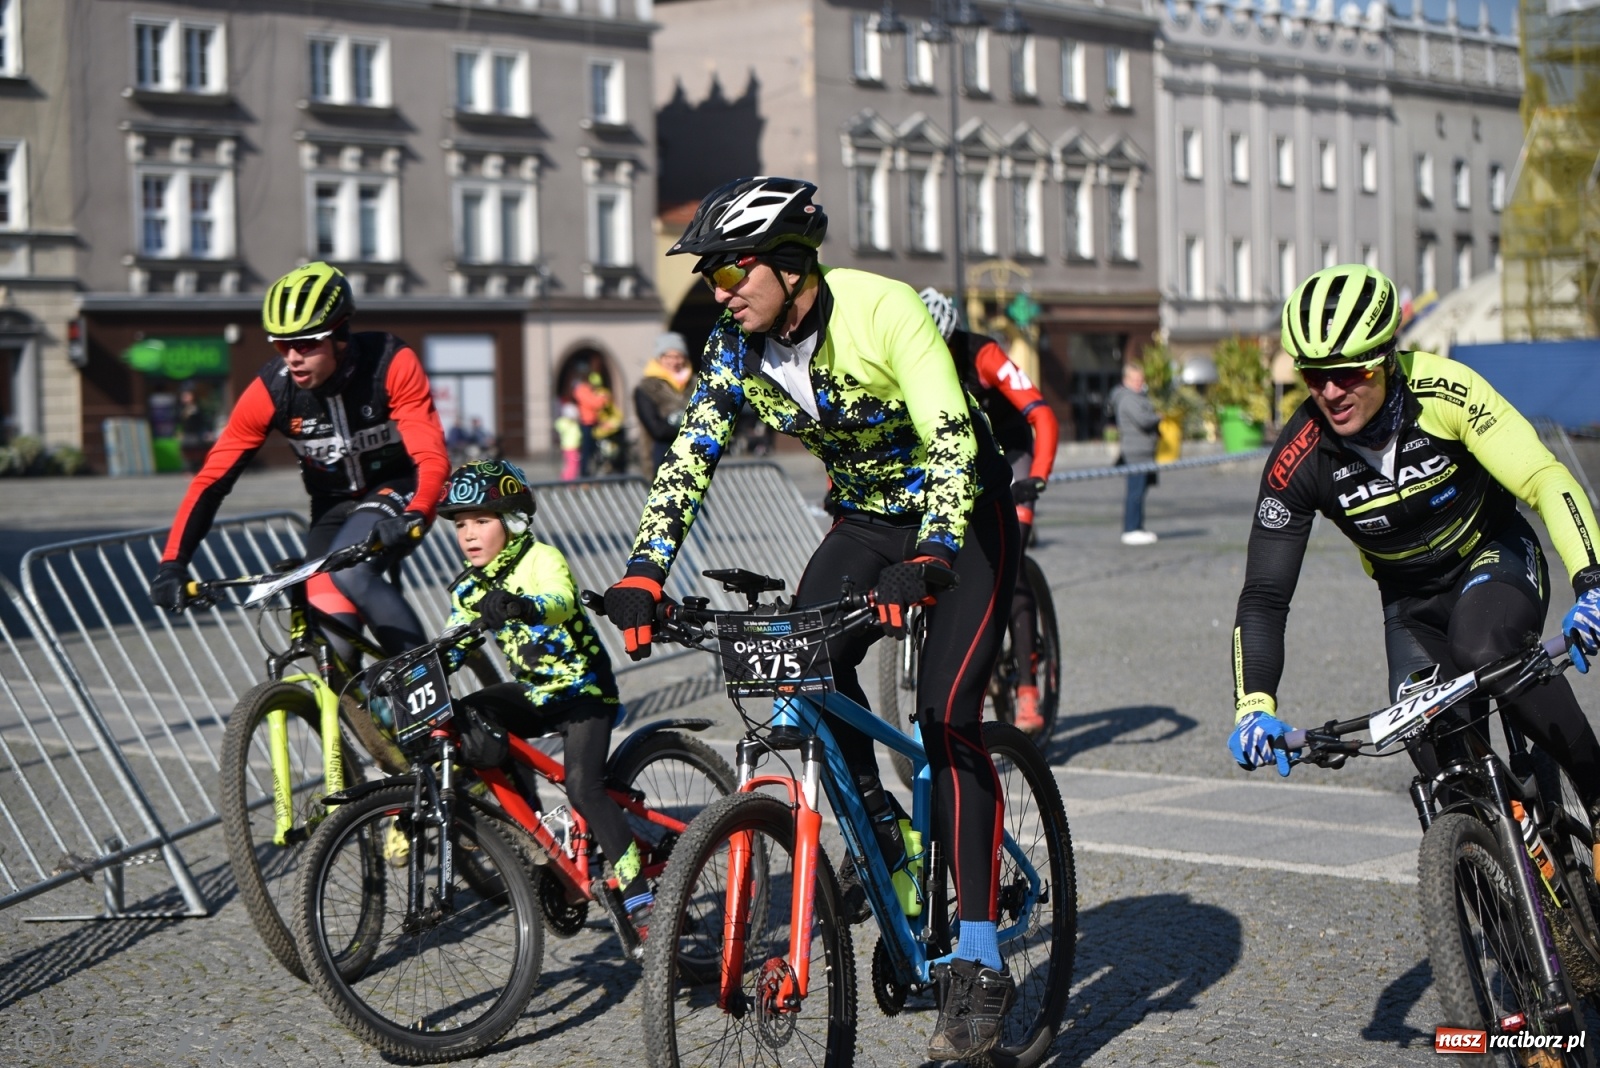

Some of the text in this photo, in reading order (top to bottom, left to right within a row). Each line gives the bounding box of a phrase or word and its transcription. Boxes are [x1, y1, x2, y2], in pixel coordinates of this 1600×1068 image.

[1365, 290, 1388, 328] HEAD
[1446, 395, 1461, 405] TEAM
[1338, 455, 1451, 508] HEAD
[1408, 469, 1452, 493] PRO TEAM
[1566, 497, 1577, 513] TEAM
[1580, 527, 1592, 551] HEAD
[747, 653, 802, 680] 175
[407, 681, 437, 715] 175
[836, 915, 854, 1026] CONTINENTAL
